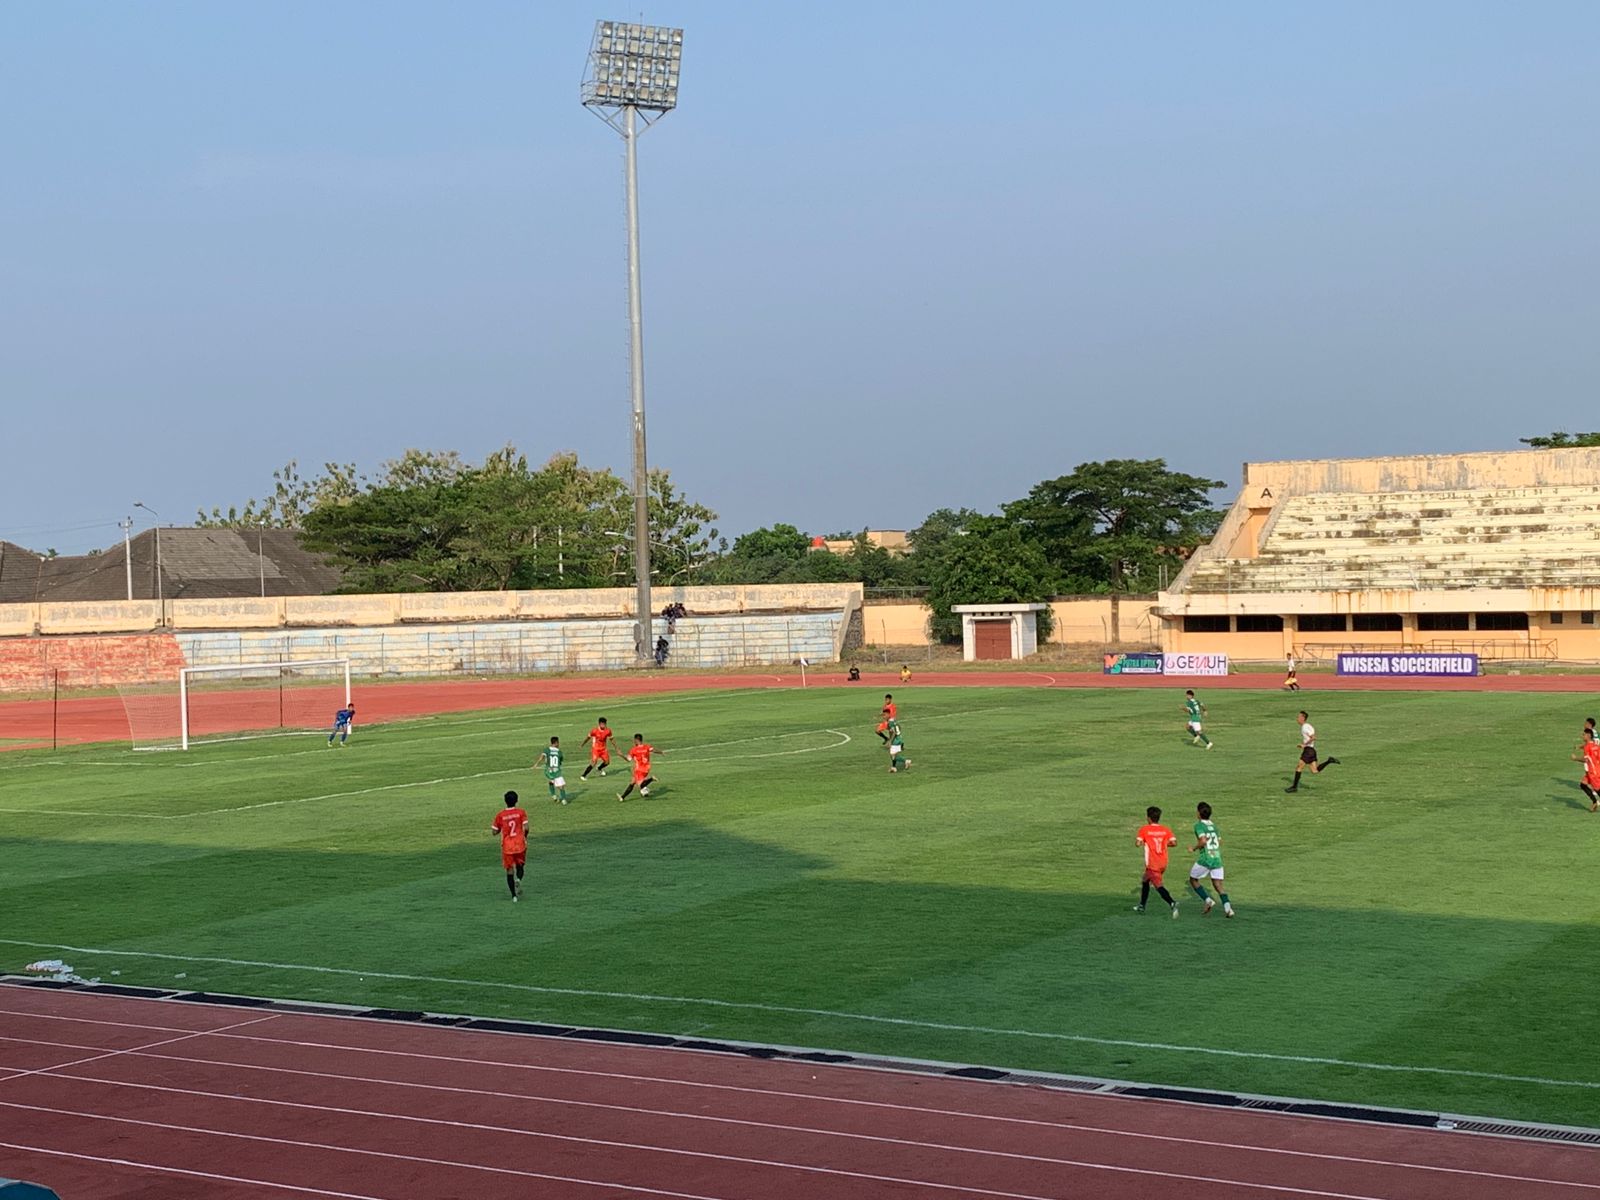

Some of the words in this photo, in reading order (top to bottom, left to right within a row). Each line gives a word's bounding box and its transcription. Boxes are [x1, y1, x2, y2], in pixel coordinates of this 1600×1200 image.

[1260, 487, 1273, 499] A
[1156, 659, 1162, 673] 2
[1342, 656, 1389, 673] WISESA
[1391, 656, 1473, 673] SOCCERFIELD
[549, 755, 559, 767] 10
[508, 820, 517, 837] 2
[1205, 831, 1220, 850] 23
